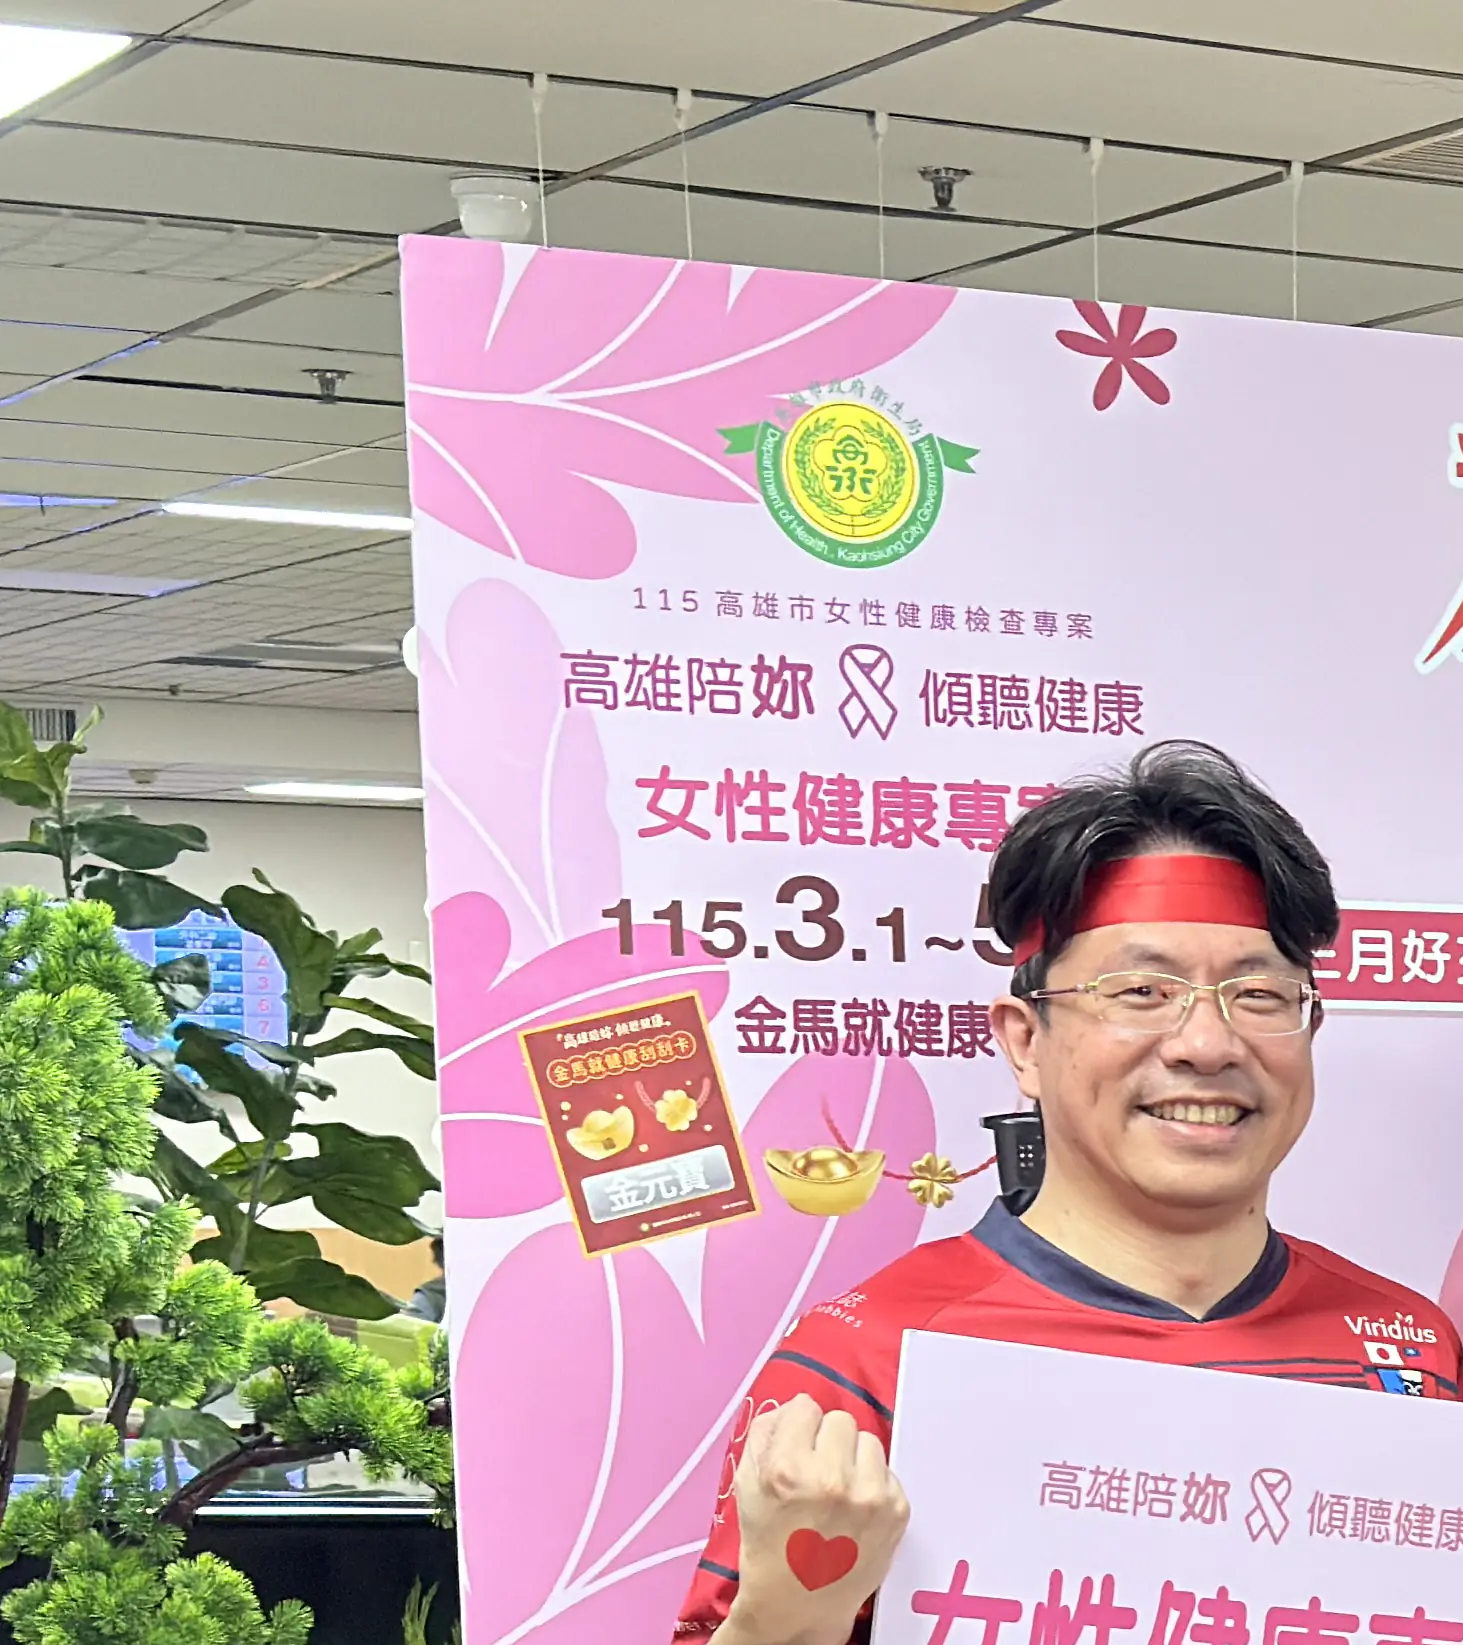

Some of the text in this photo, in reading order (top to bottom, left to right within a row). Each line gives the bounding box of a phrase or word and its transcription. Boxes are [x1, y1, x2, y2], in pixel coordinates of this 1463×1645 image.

[631, 587, 1095, 640] 115 高雄市女性健康檢查專案
[560, 649, 1145, 737] 高雄陪妳 傾聽健康
[734, 995, 997, 1059] 金馬就健康
[1343, 1313, 1438, 1344] Viridius
[1038, 1461, 1231, 1526] 高雄陪妳
